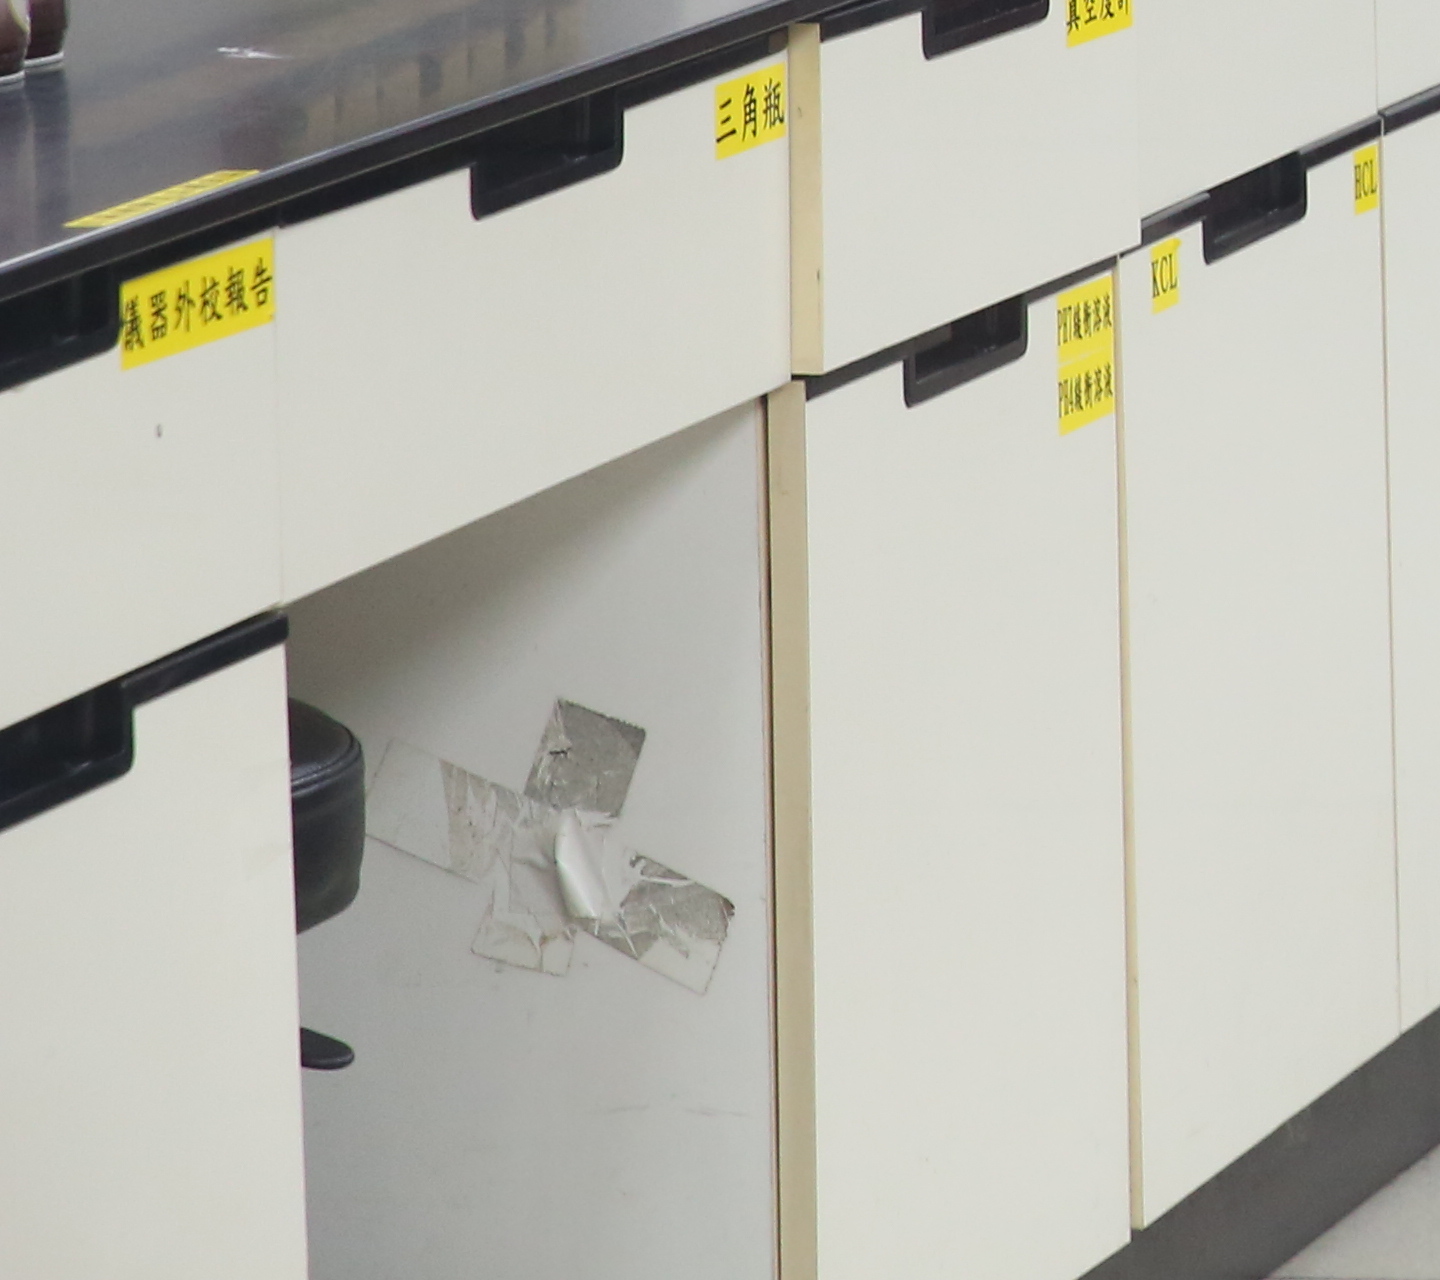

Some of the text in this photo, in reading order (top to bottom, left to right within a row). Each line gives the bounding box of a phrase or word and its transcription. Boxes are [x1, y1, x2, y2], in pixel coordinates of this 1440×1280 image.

[716, 77, 785, 143] 三角瓶
[1354, 159, 1377, 200] HCL
[1151, 252, 1178, 299] KCL
[122, 256, 273, 352] 儀器外校報告
